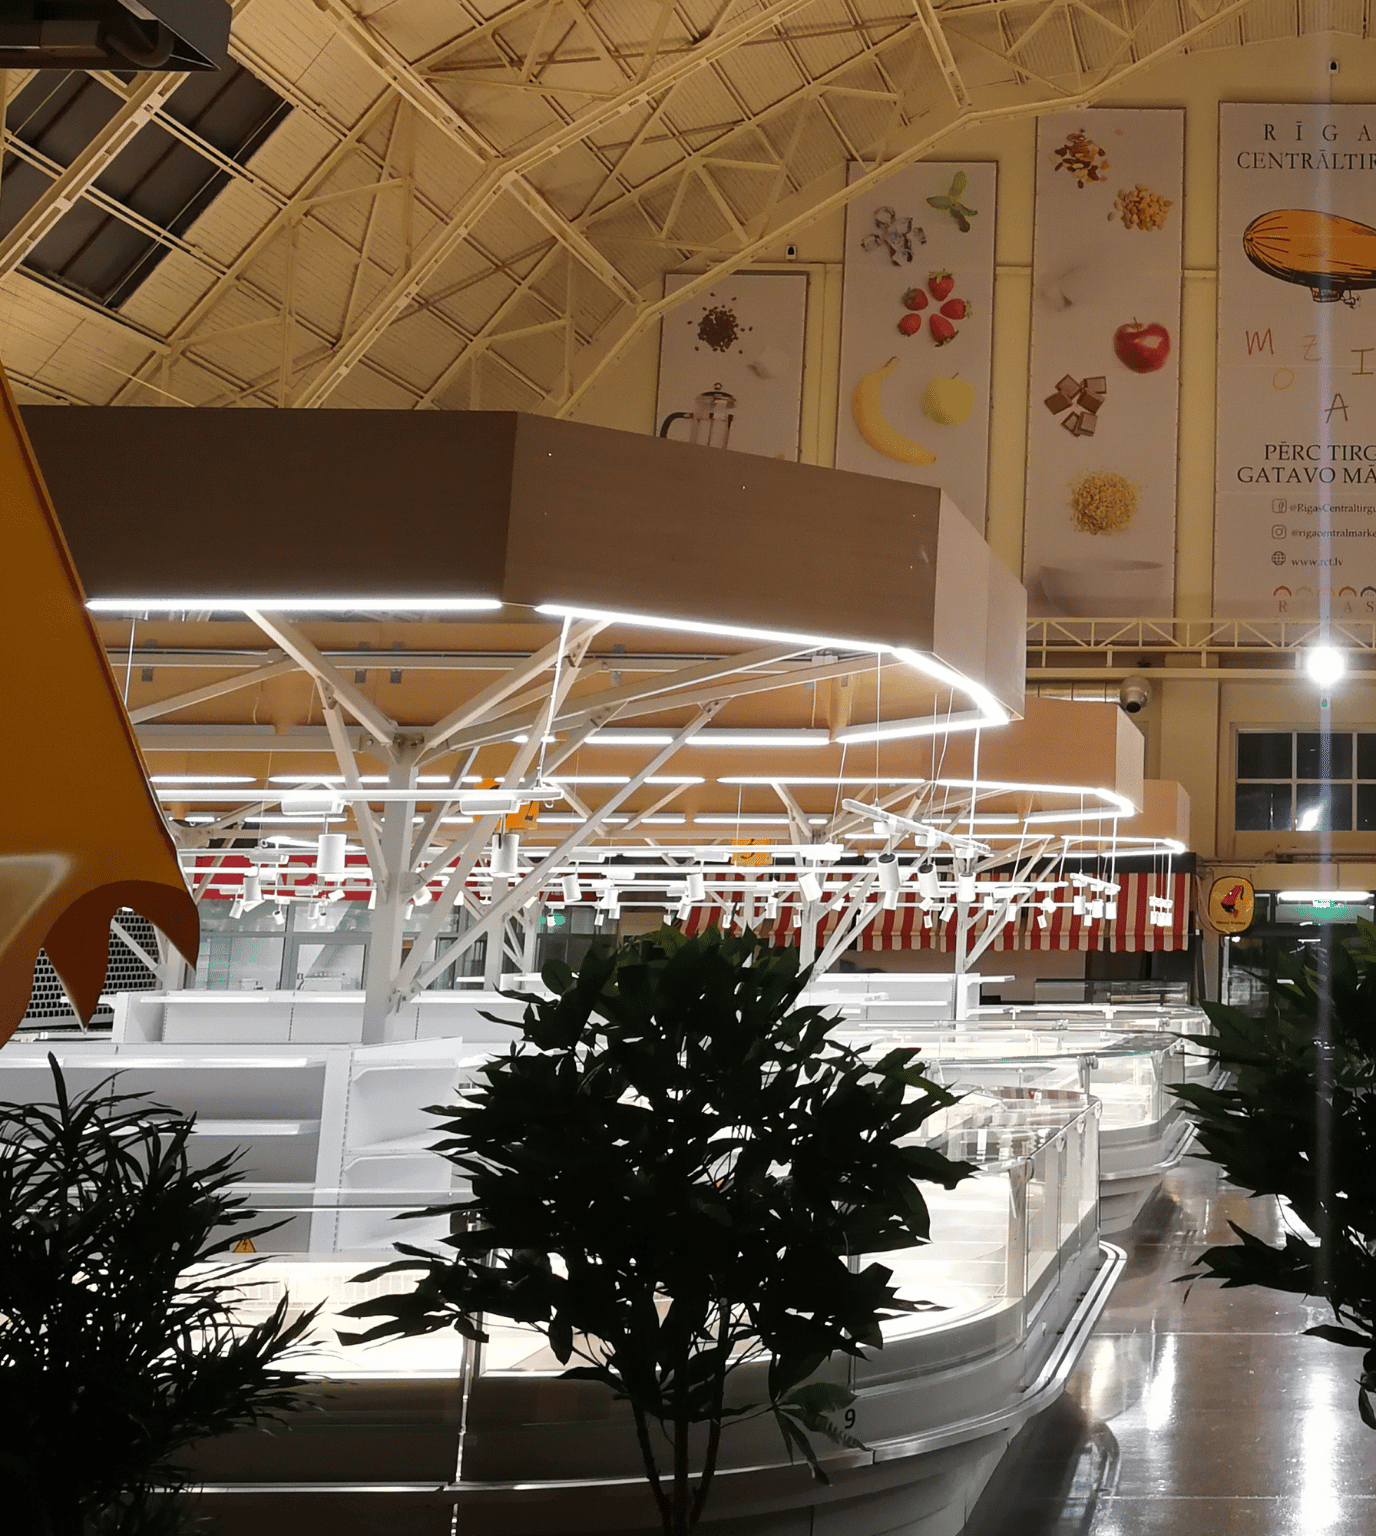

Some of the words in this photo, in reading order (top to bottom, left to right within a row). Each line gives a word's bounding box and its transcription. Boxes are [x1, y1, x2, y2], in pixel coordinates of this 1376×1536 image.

[1245, 328, 1274, 355] M
[1324, 393, 1349, 424] A
[1263, 441, 1321, 462] PĒRC
[1236, 466, 1336, 484] GATAVO
[844, 1408, 856, 1429] 9
